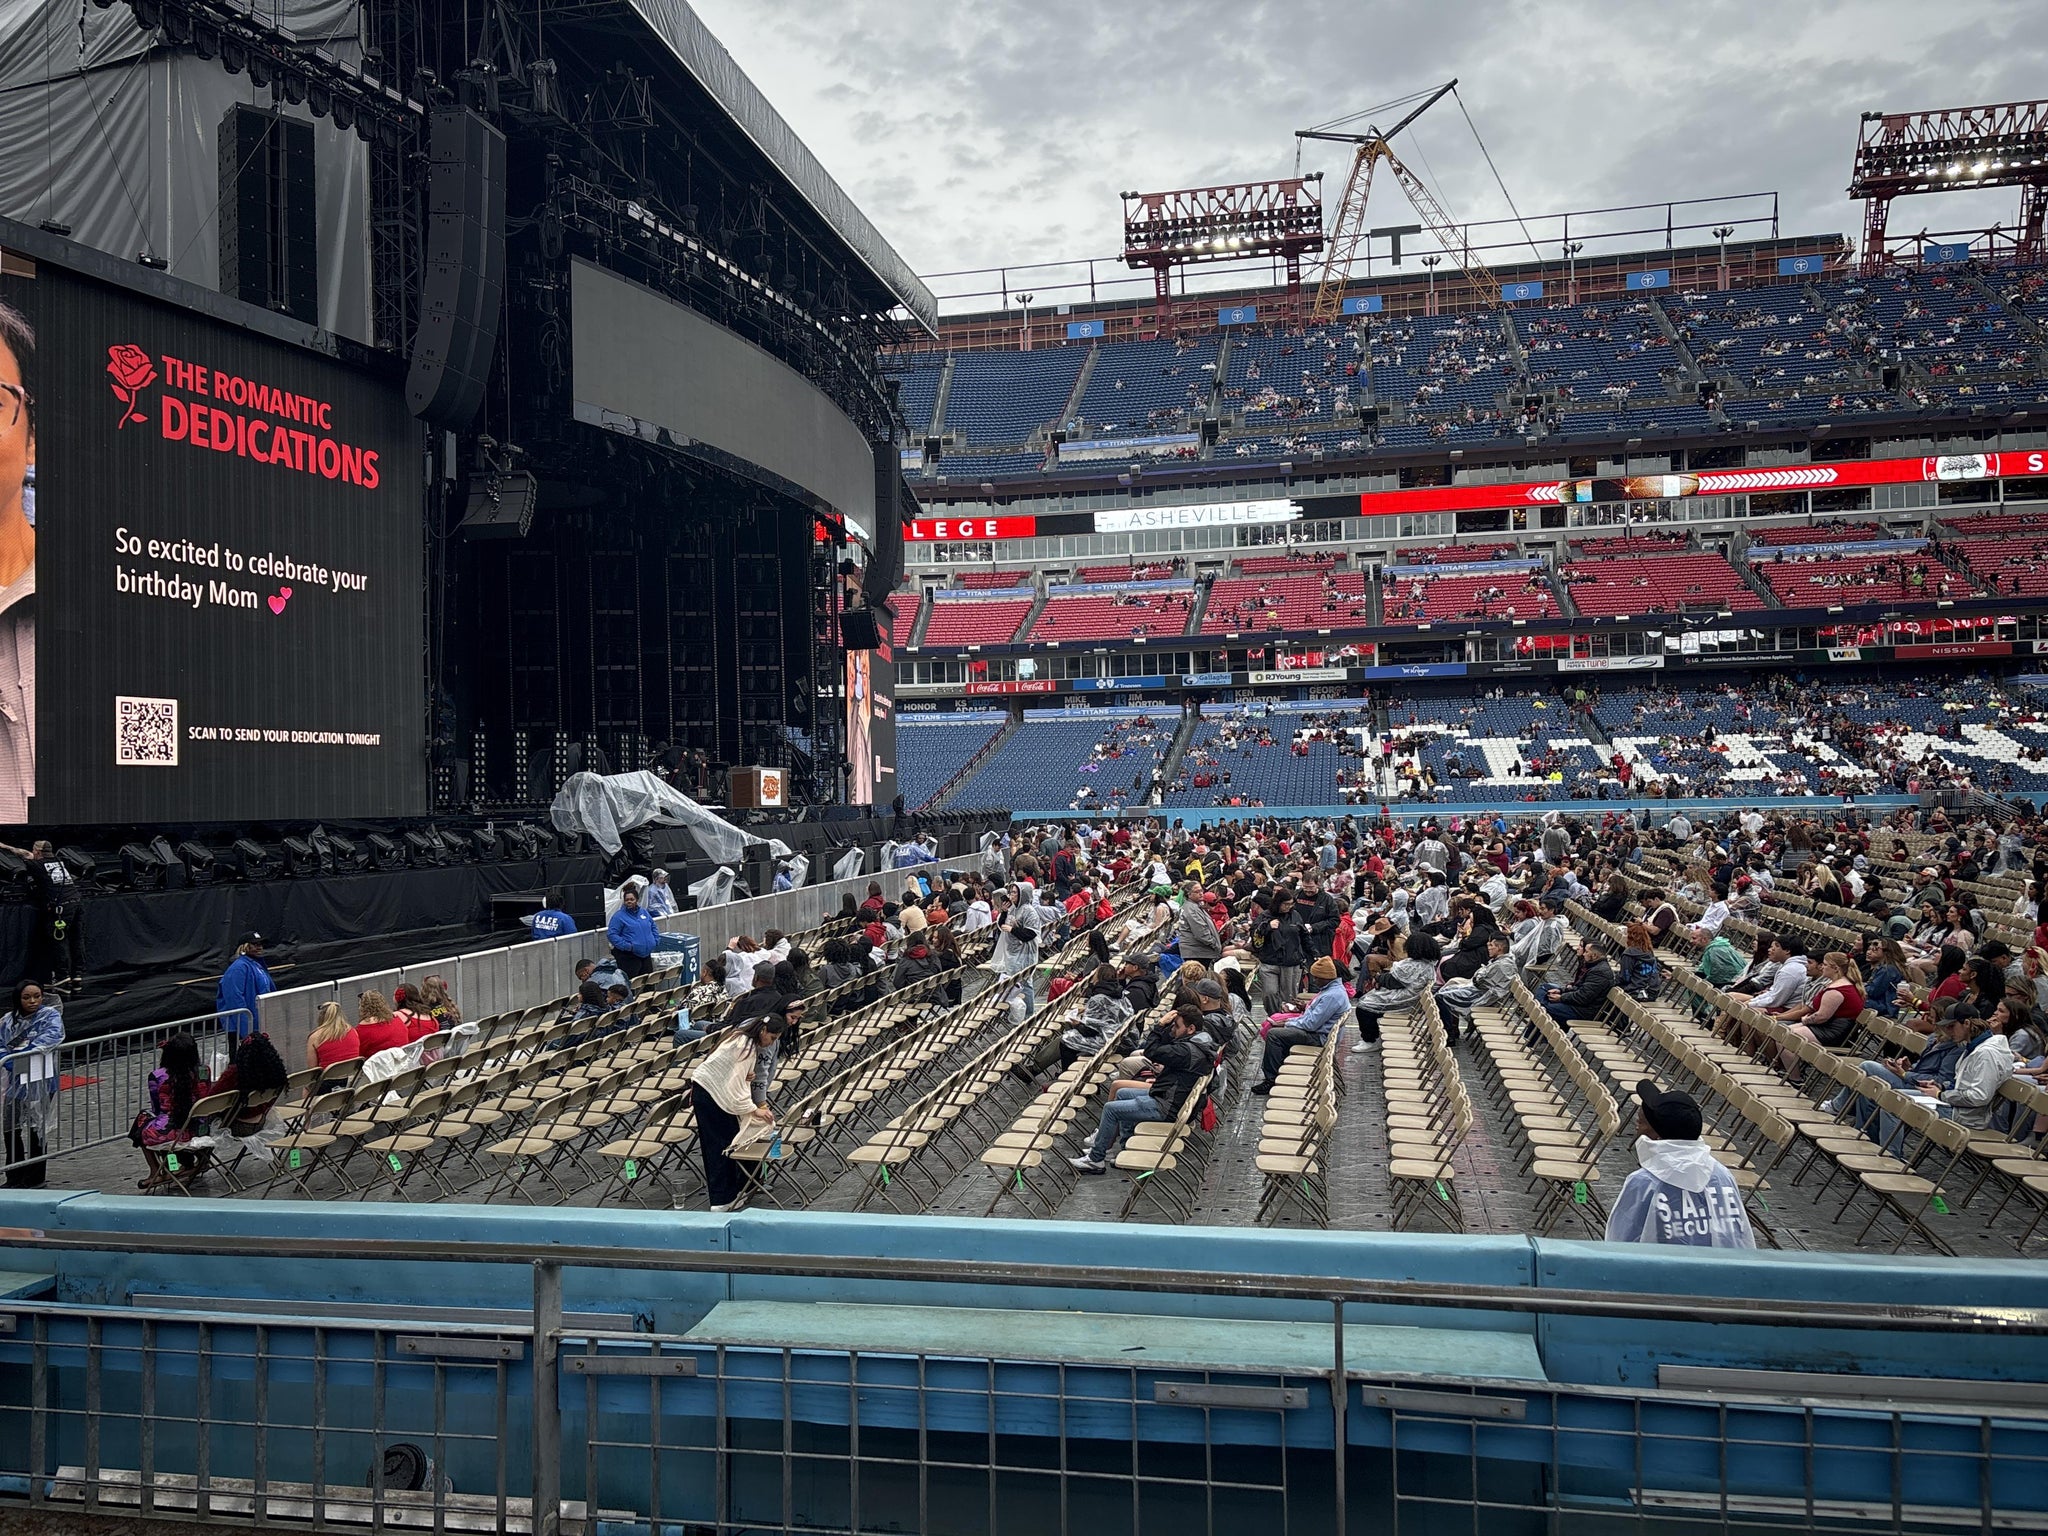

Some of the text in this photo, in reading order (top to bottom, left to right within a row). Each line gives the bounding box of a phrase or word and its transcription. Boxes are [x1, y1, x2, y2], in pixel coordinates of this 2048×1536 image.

[161, 355, 332, 430] THE ROMANTIC
[161, 394, 380, 490] DEDICATIONS
[1128, 504, 1259, 527] ASHEVILLE
[115, 527, 367, 593] So excited to celebrate your
[116, 565, 258, 609] birthday Mom
[1932, 646, 1975, 654] NISSAN
[1199, 673, 1231, 681] Gallagher
[1265, 673, 1301, 681] RJYoung
[976, 684, 1000, 693] Coca-Cola
[1021, 682, 1046, 691] Coca-Cola
[903, 703, 937, 711] HONOR
[188, 726, 380, 746] SCAN TO SEND YOUR DEDICATION TONIGHT
